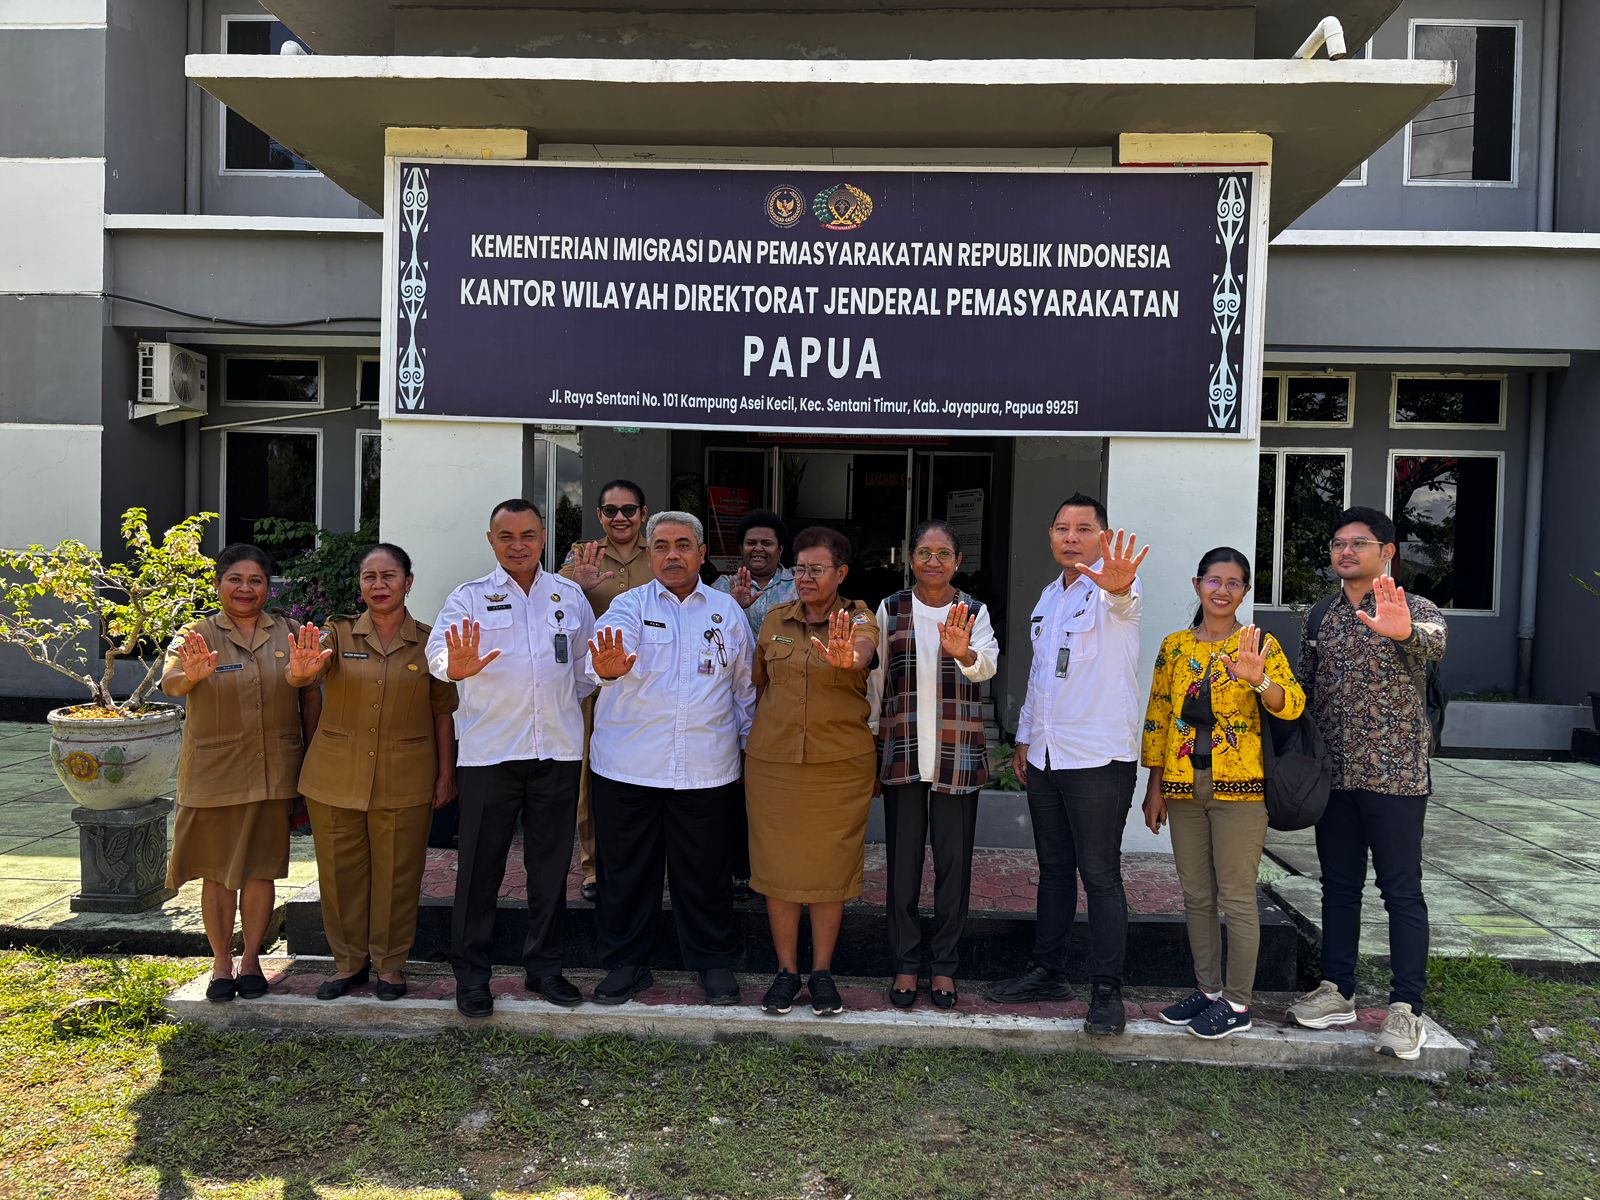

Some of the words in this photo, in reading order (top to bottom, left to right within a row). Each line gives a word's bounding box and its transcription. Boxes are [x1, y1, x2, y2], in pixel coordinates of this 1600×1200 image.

[471, 234, 609, 261] KEMENTERIAN
[613, 237, 704, 263] IMIGRASI
[708, 239, 752, 264] DAN
[757, 240, 953, 267] PEMASYARAKATAN
[957, 242, 1053, 268] REPUBLIK
[1058, 243, 1171, 269] INDONESIA
[460, 278, 556, 307] KANTOR
[562, 280, 669, 311] WILAYAH
[674, 283, 819, 314] DIREKTORAT
[823, 286, 941, 316] JENDERAL
[946, 287, 1179, 318] PEMASYARAKATAN
[743, 335, 882, 379] PAPUA
[549, 389, 562, 404] Jl.
[564, 390, 594, 409] Raya
[595, 390, 640, 406] Sentani
[642, 392, 661, 407] No.
[663, 393, 679, 408] 101
[680, 393, 738, 414] Kampung
[740, 394, 765, 410] Asei
[766, 395, 798, 413] Kecil,
[799, 397, 825, 412] Kec.
[827, 396, 872, 413] Sentani
[874, 397, 911, 415] Timur,
[913, 398, 940, 413] Kab.
[942, 399, 1003, 419] Jayapura,
[1005, 400, 1044, 419] Papua
[1045, 399, 1079, 415] 99251
